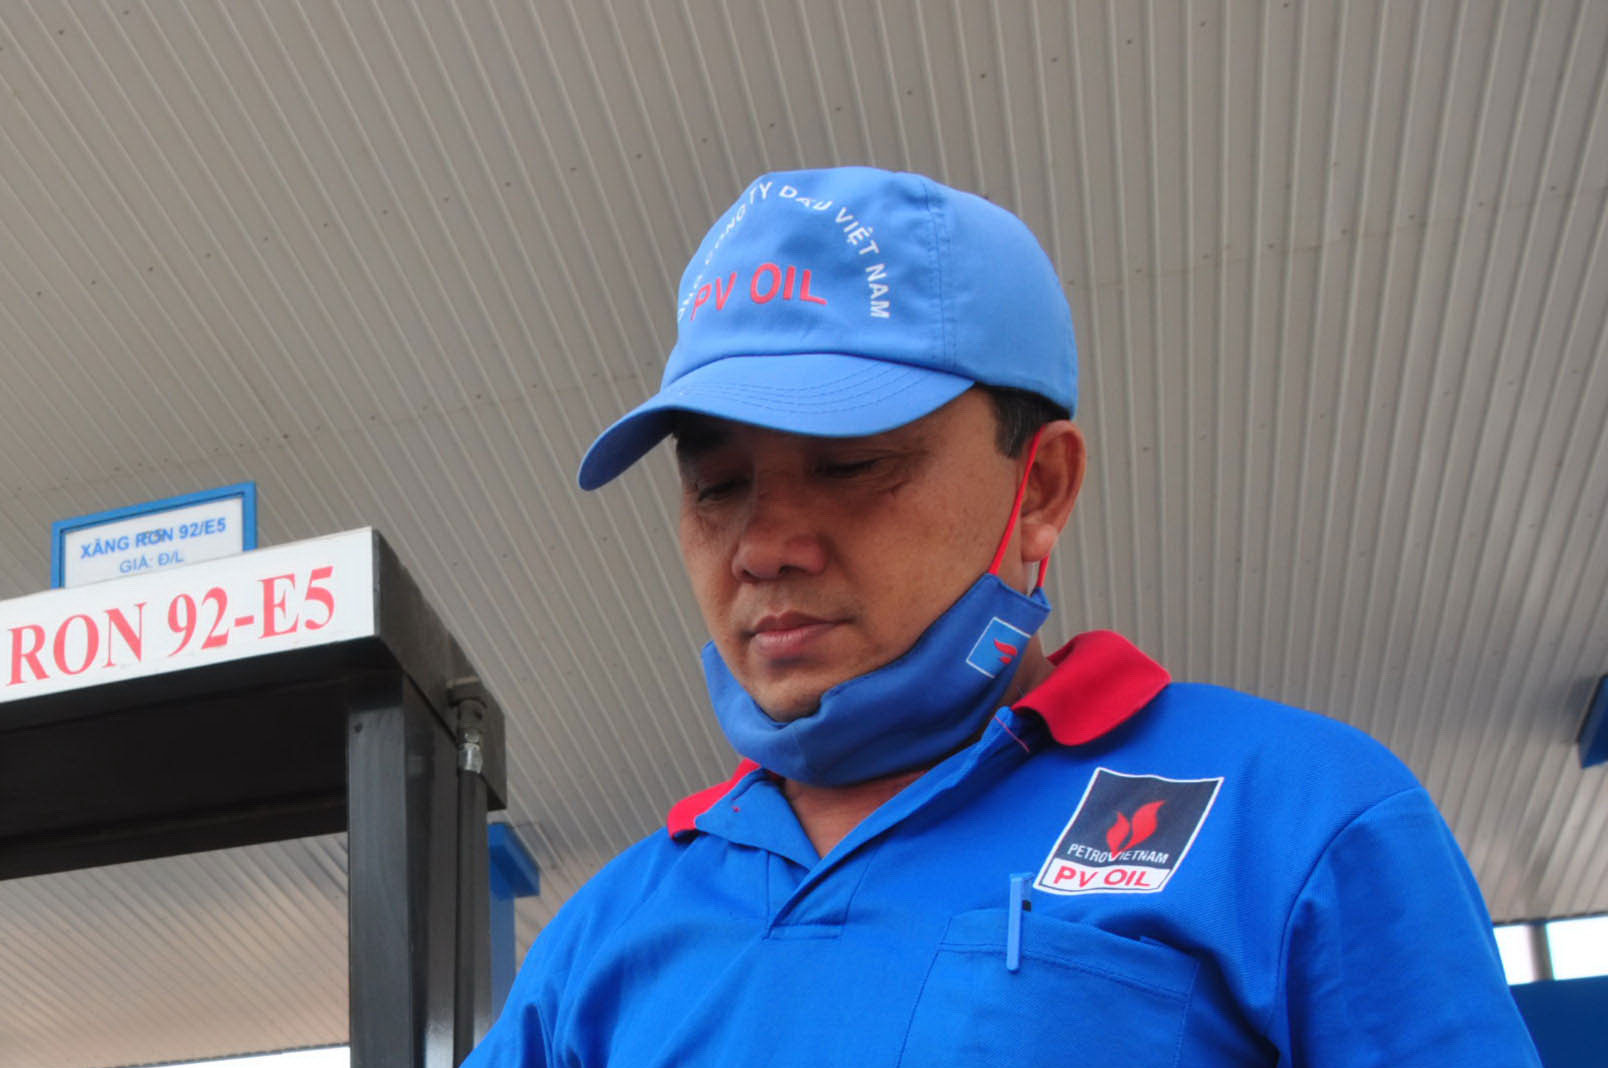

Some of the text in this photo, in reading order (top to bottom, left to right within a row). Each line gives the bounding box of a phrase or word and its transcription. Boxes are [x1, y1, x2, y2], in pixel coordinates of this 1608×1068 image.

[690, 271, 737, 321] PV
[750, 262, 828, 305] OIL
[865, 263, 891, 320] NAM
[79, 534, 130, 559] XĂNG
[178, 517, 227, 540] 92/E5
[6, 602, 148, 686] RON
[167, 565, 336, 656] 92-E5
[1053, 866, 1152, 888] PV OIL
[1067, 843, 1170, 866] PETROVIETNAM
